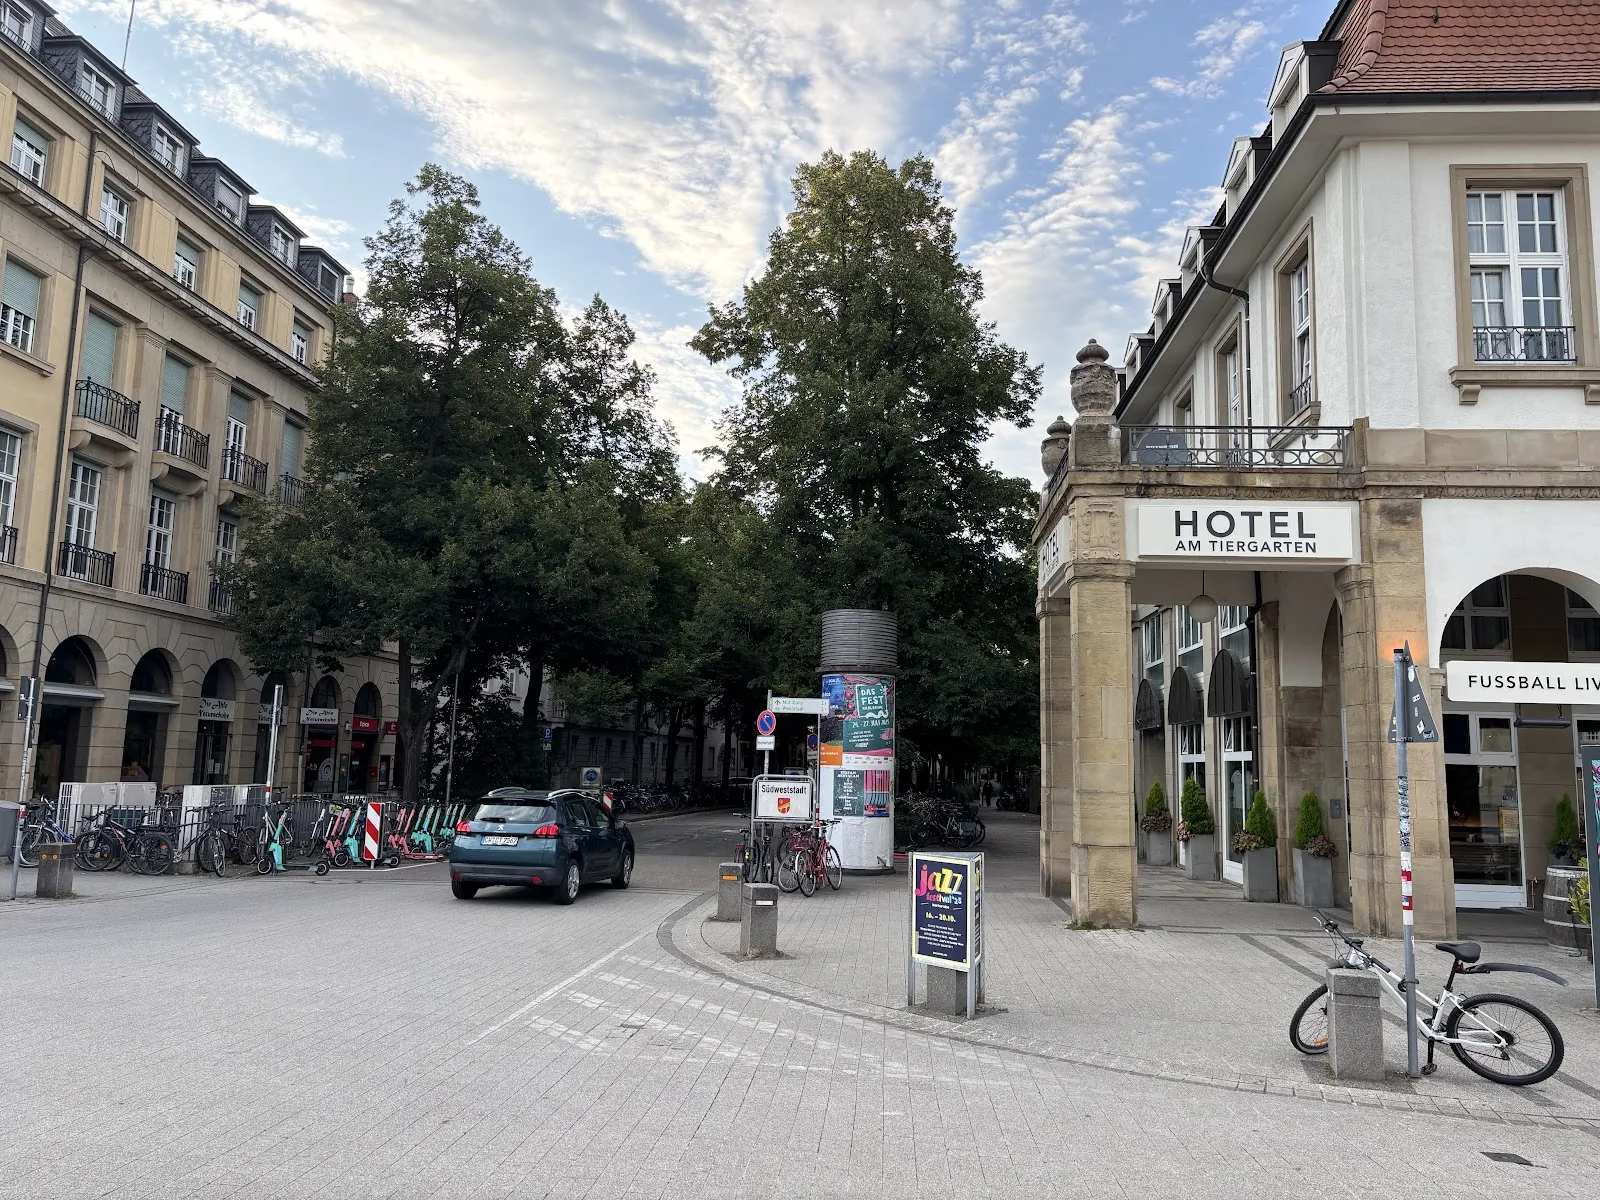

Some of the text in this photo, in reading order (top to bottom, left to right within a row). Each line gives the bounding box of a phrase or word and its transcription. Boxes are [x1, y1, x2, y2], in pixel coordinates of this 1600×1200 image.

[1174, 510, 1316, 538] HOTEL
[1042, 529, 1059, 572] HOTEL
[1175, 540, 1317, 554] AM TIERGARTEN
[1468, 675, 1566, 690] FUSSBALL
[861, 688, 876, 696] DAS
[199, 698, 212, 709] Die
[861, 695, 884, 705] FEST
[761, 784, 807, 795] Südweststadt
[914, 864, 964, 896] jazz
[926, 892, 952, 904] festival
